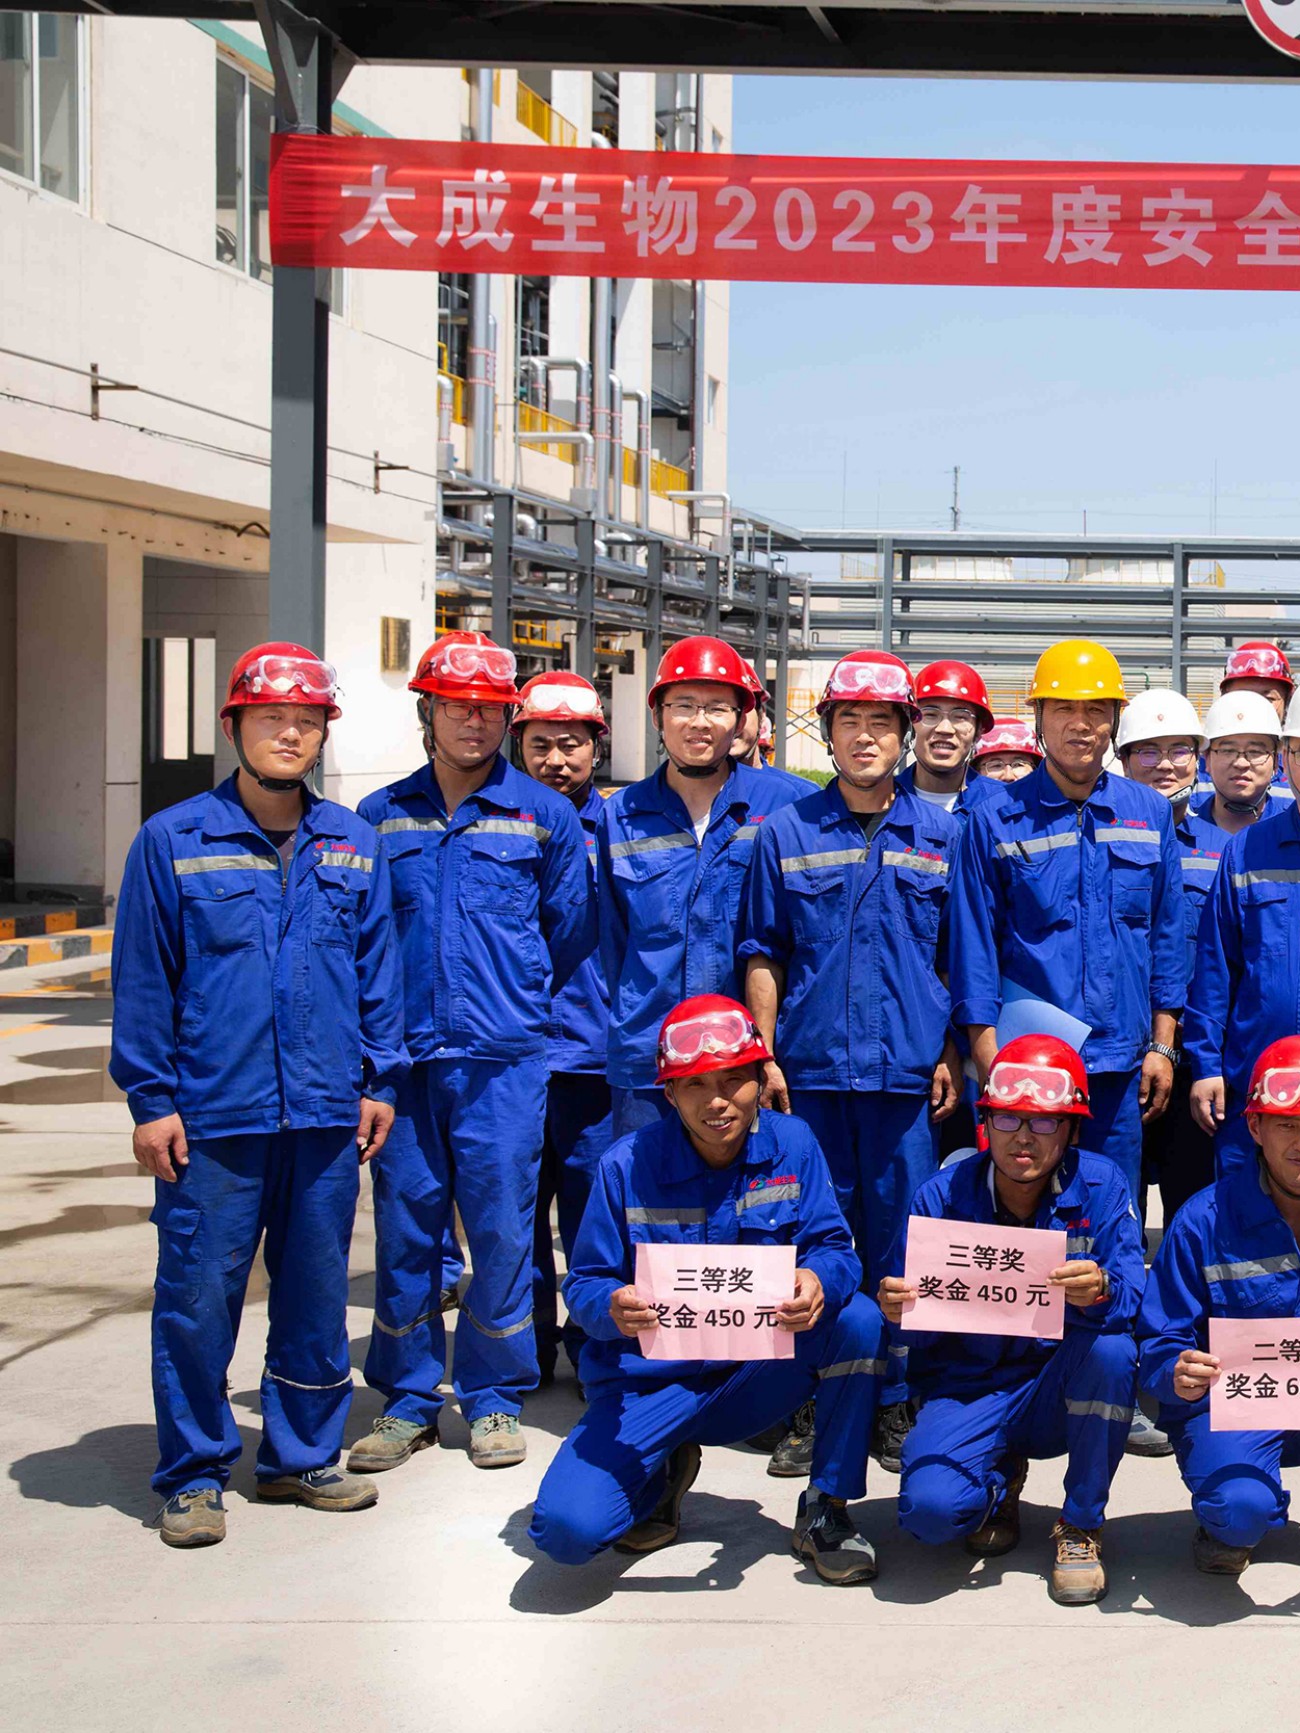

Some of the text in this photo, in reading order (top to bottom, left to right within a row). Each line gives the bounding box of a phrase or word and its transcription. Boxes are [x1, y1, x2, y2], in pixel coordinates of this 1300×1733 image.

[945, 1244, 1025, 1273] 三等奖
[673, 1266, 754, 1294] 三等奖
[918, 1275, 1051, 1307] 奖金 450 元
[704, 1308, 745, 1328] 450
[753, 1305, 780, 1330] 元
[1225, 1373, 1279, 1400] 奖金
